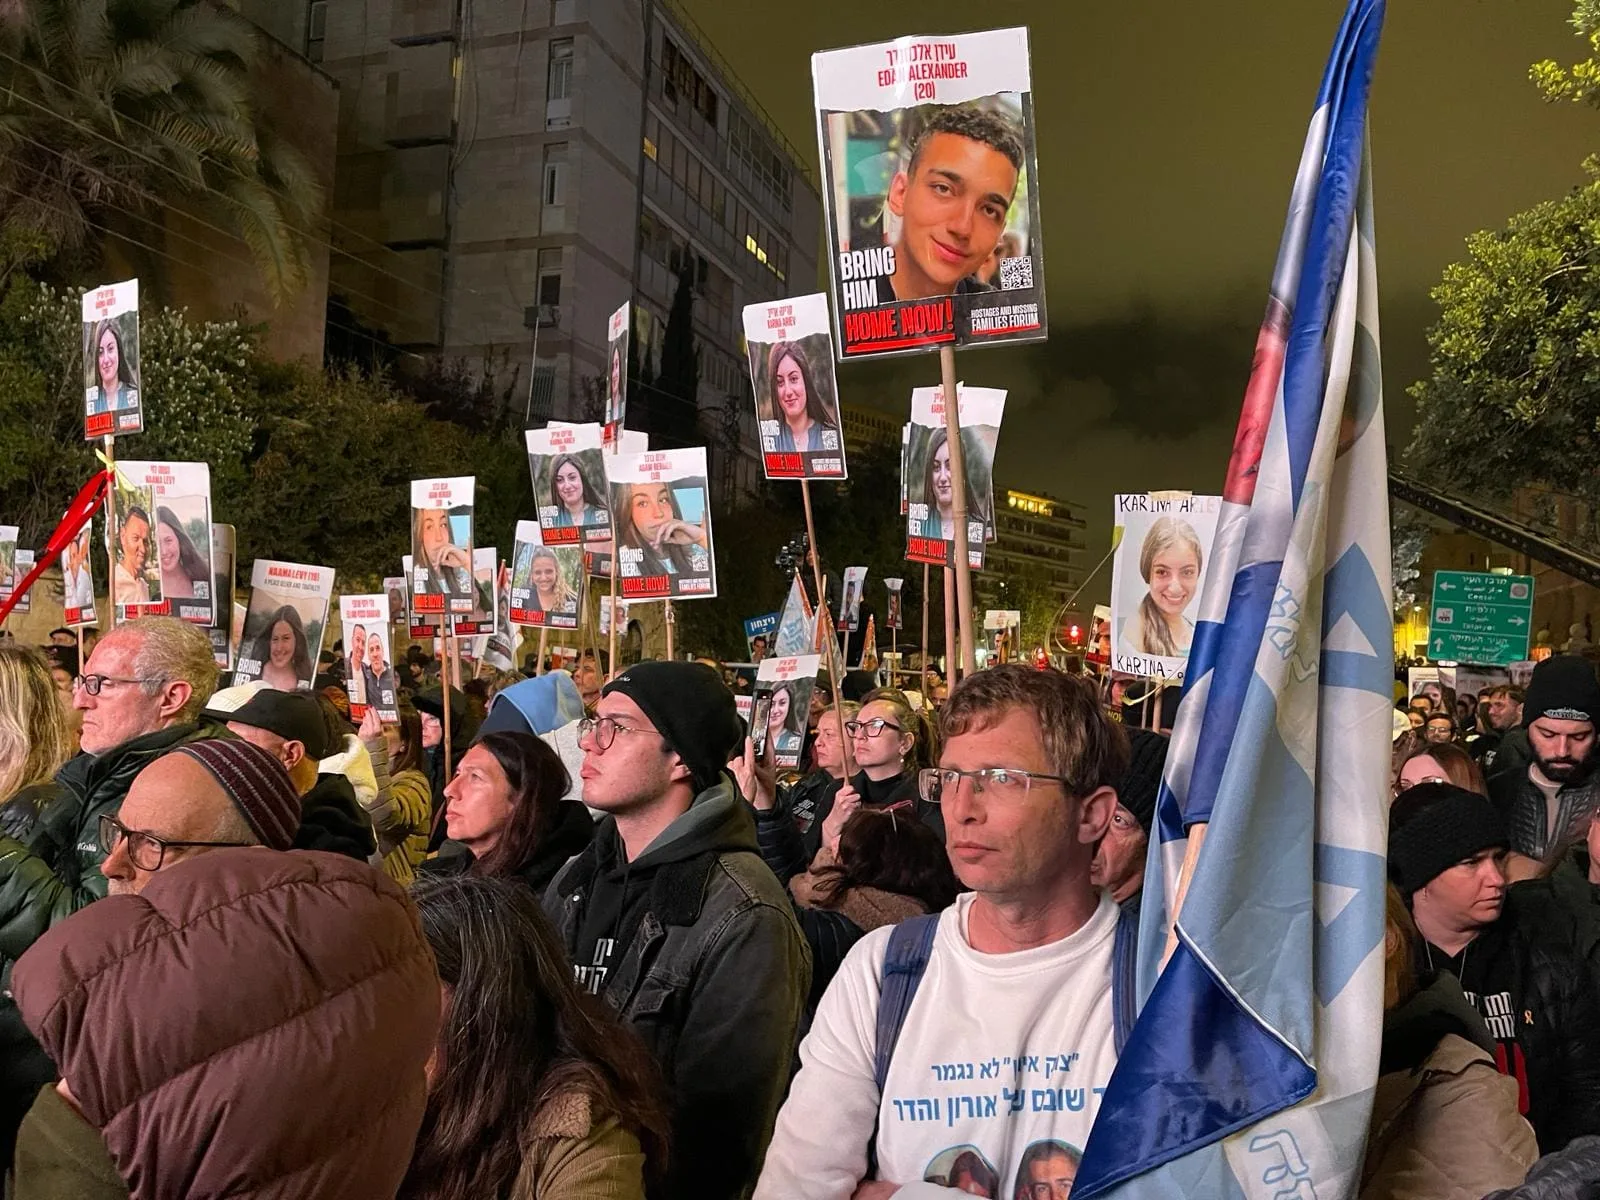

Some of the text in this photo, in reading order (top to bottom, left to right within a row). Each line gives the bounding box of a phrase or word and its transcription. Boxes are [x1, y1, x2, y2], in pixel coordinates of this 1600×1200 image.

[935, 44, 956, 61] עידן
[909, 62, 968, 81] ALEXANDER
[914, 81, 936, 101] (20)
[840, 247, 896, 281] BRING
[842, 279, 879, 310] HIM
[845, 297, 954, 342] HOME NOW!
[971, 303, 1038, 318] HOSTAGES AND MISSING
[972, 313, 1039, 331] FAMILIES FORUM
[619, 548, 644, 562] BRING
[268, 567, 291, 578] NAAMA
[292, 570, 308, 580] LEVY
[622, 574, 670, 592] HOME NOW!
[750, 616, 776, 632] ניצחון
[237, 657, 262, 675] BRING
[931, 1062, 974, 1082] נגמר
[980, 1057, 1000, 1079] לא
[893, 1097, 941, 1122] והדר
[1032, 1087, 1085, 1113] שובם
[947, 1093, 998, 1127] אורון
